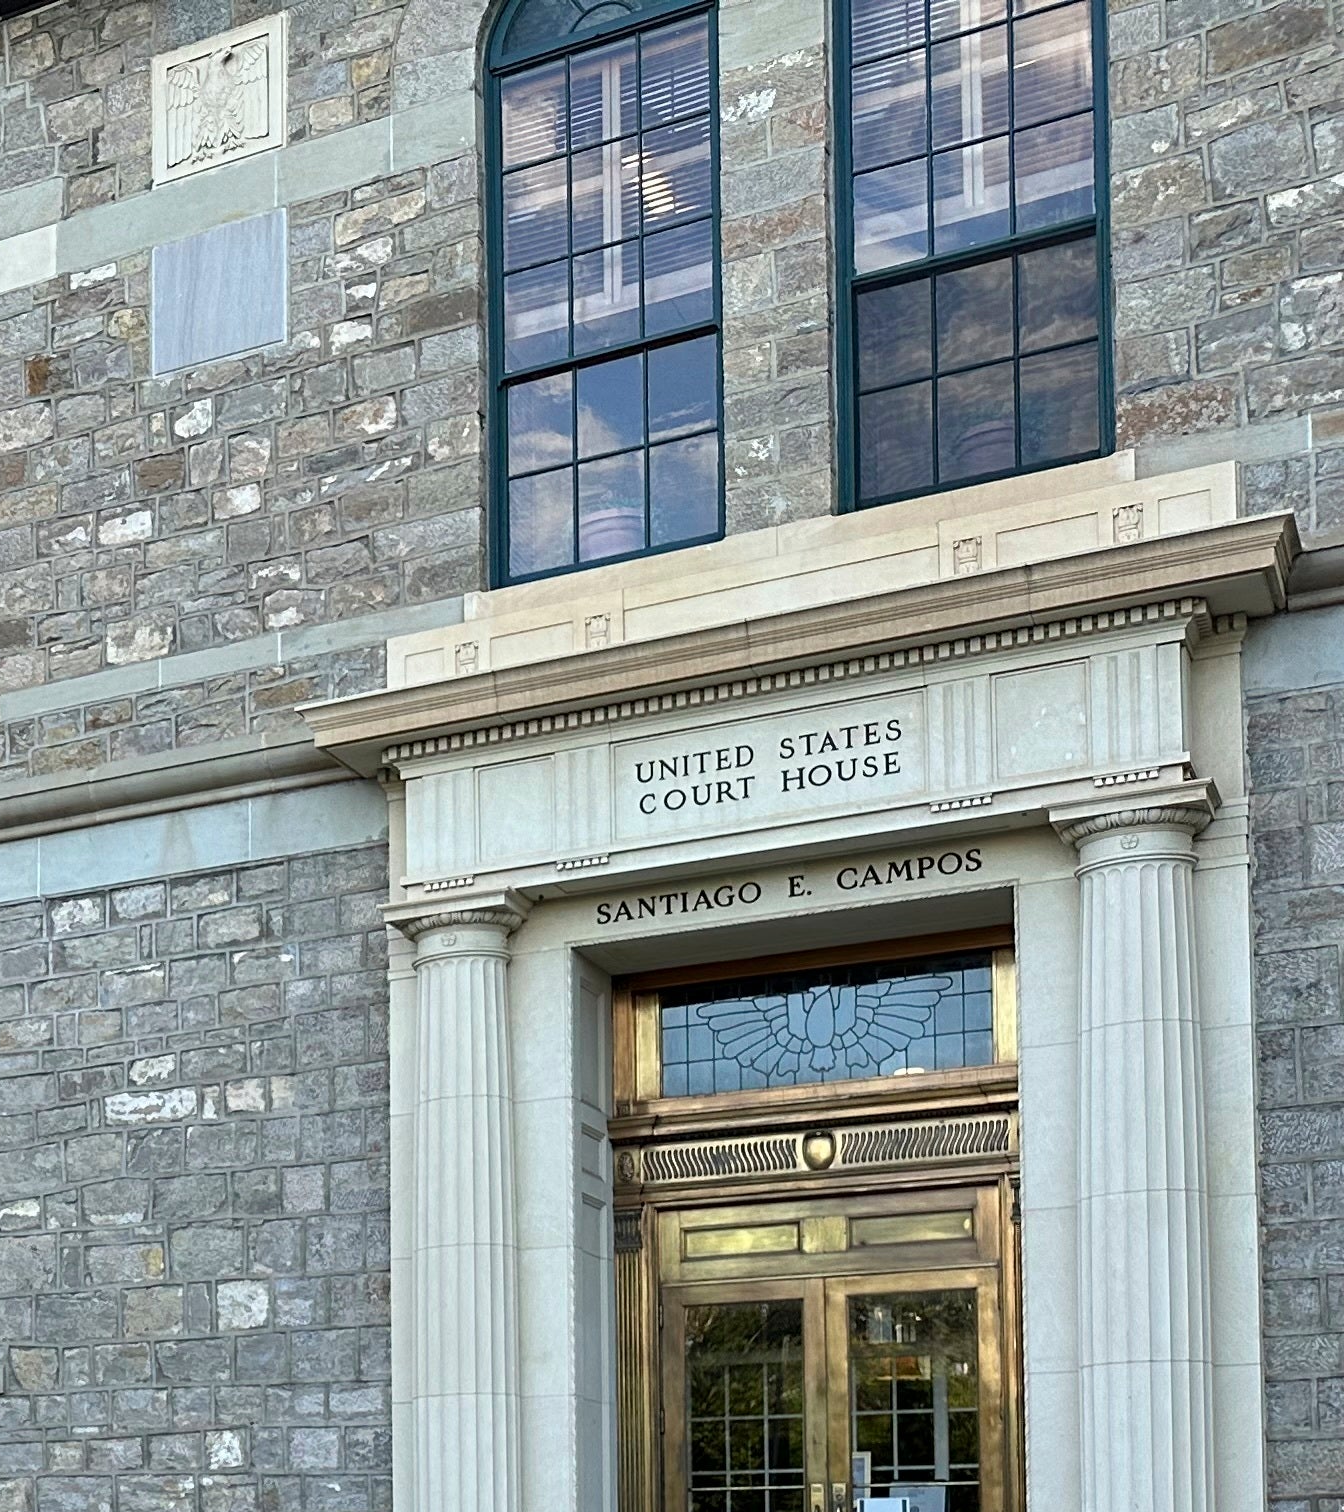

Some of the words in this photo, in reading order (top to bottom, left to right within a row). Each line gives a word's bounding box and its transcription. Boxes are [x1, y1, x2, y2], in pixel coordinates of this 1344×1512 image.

[634, 744, 754, 783] UNITED
[779, 719, 902, 759] STATES
[639, 775, 756, 814] COURT
[781, 751, 902, 792] HOUSE
[596, 881, 761, 924] SANTIAGO
[787, 875, 812, 898] E.
[836, 848, 982, 890] CAMPOS
